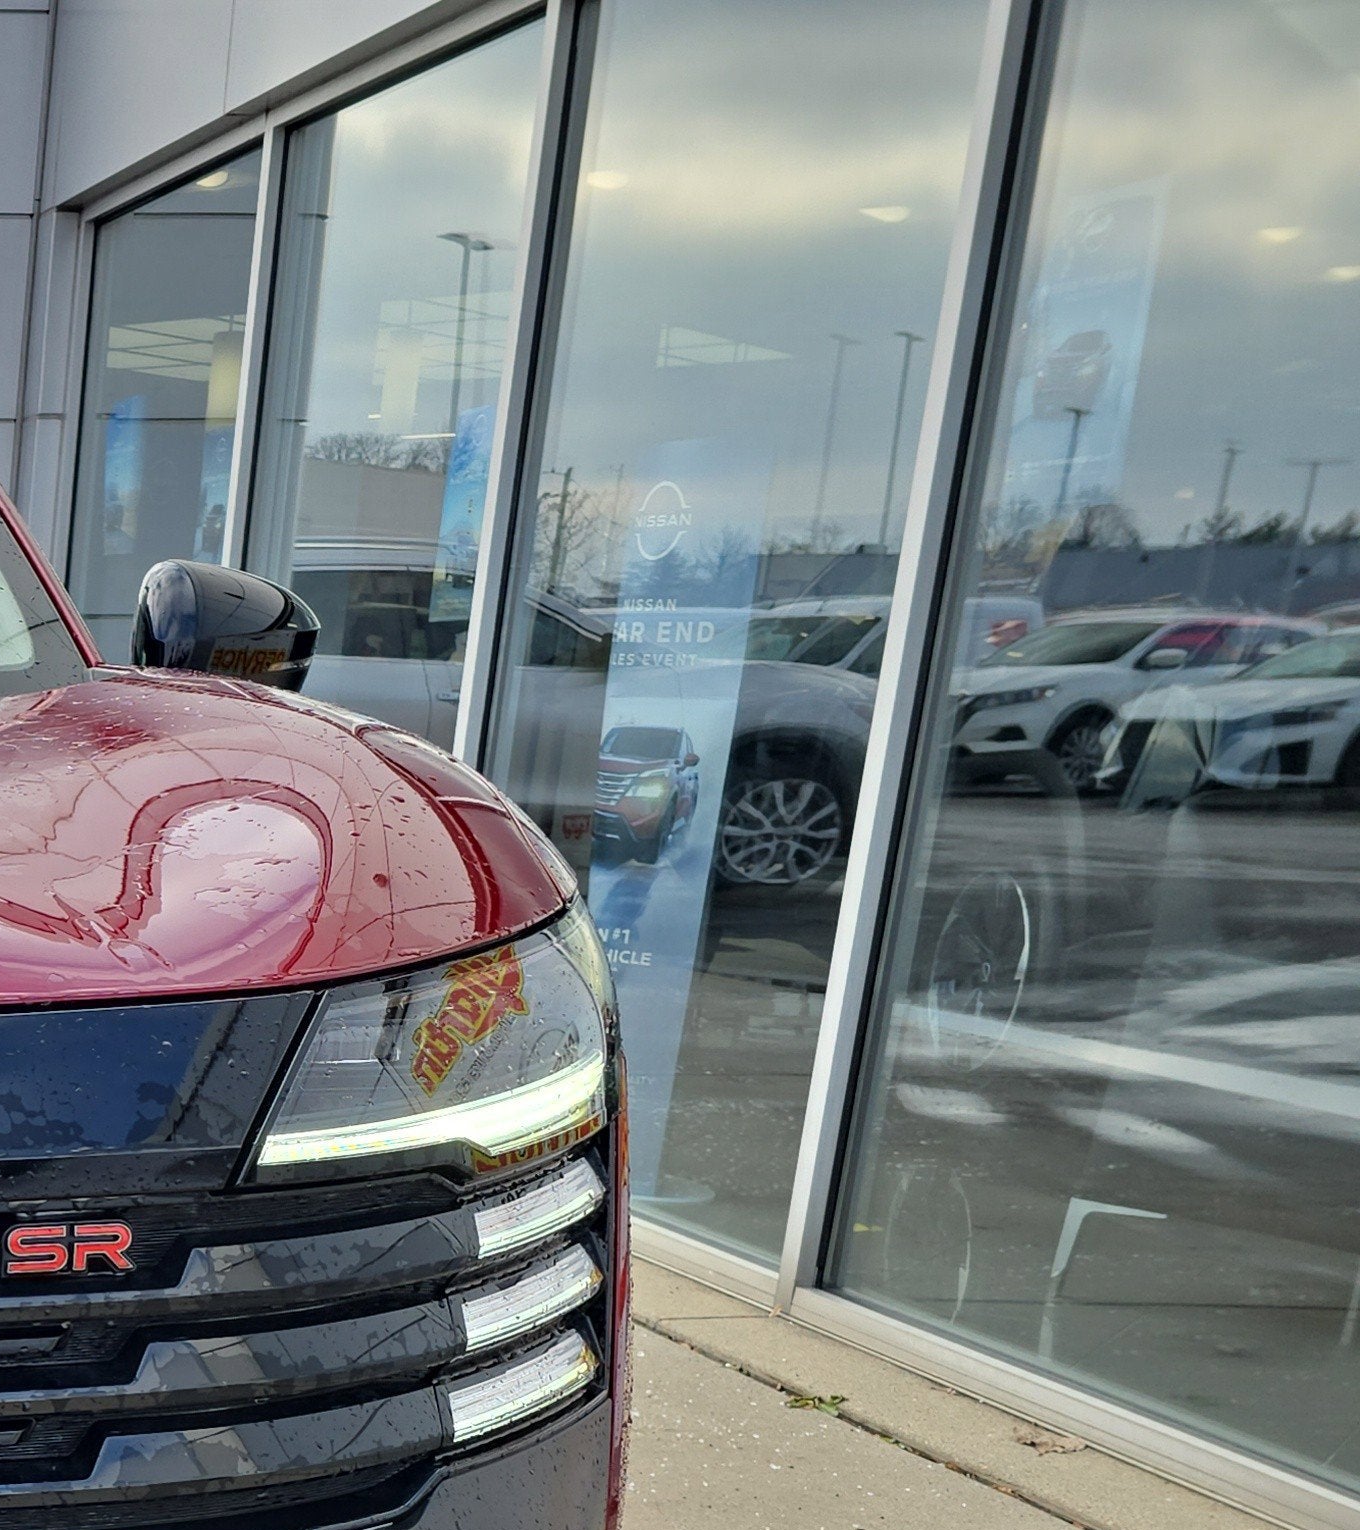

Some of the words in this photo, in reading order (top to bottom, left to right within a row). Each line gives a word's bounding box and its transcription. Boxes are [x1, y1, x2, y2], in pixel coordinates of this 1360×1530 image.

[635, 513, 692, 529] NISSAN
[623, 598, 678, 612] NISSAN
[657, 620, 716, 643] END
[642, 652, 698, 667] EVENT
[612, 928, 631, 944] #1
[6, 1223, 134, 1274] SR
